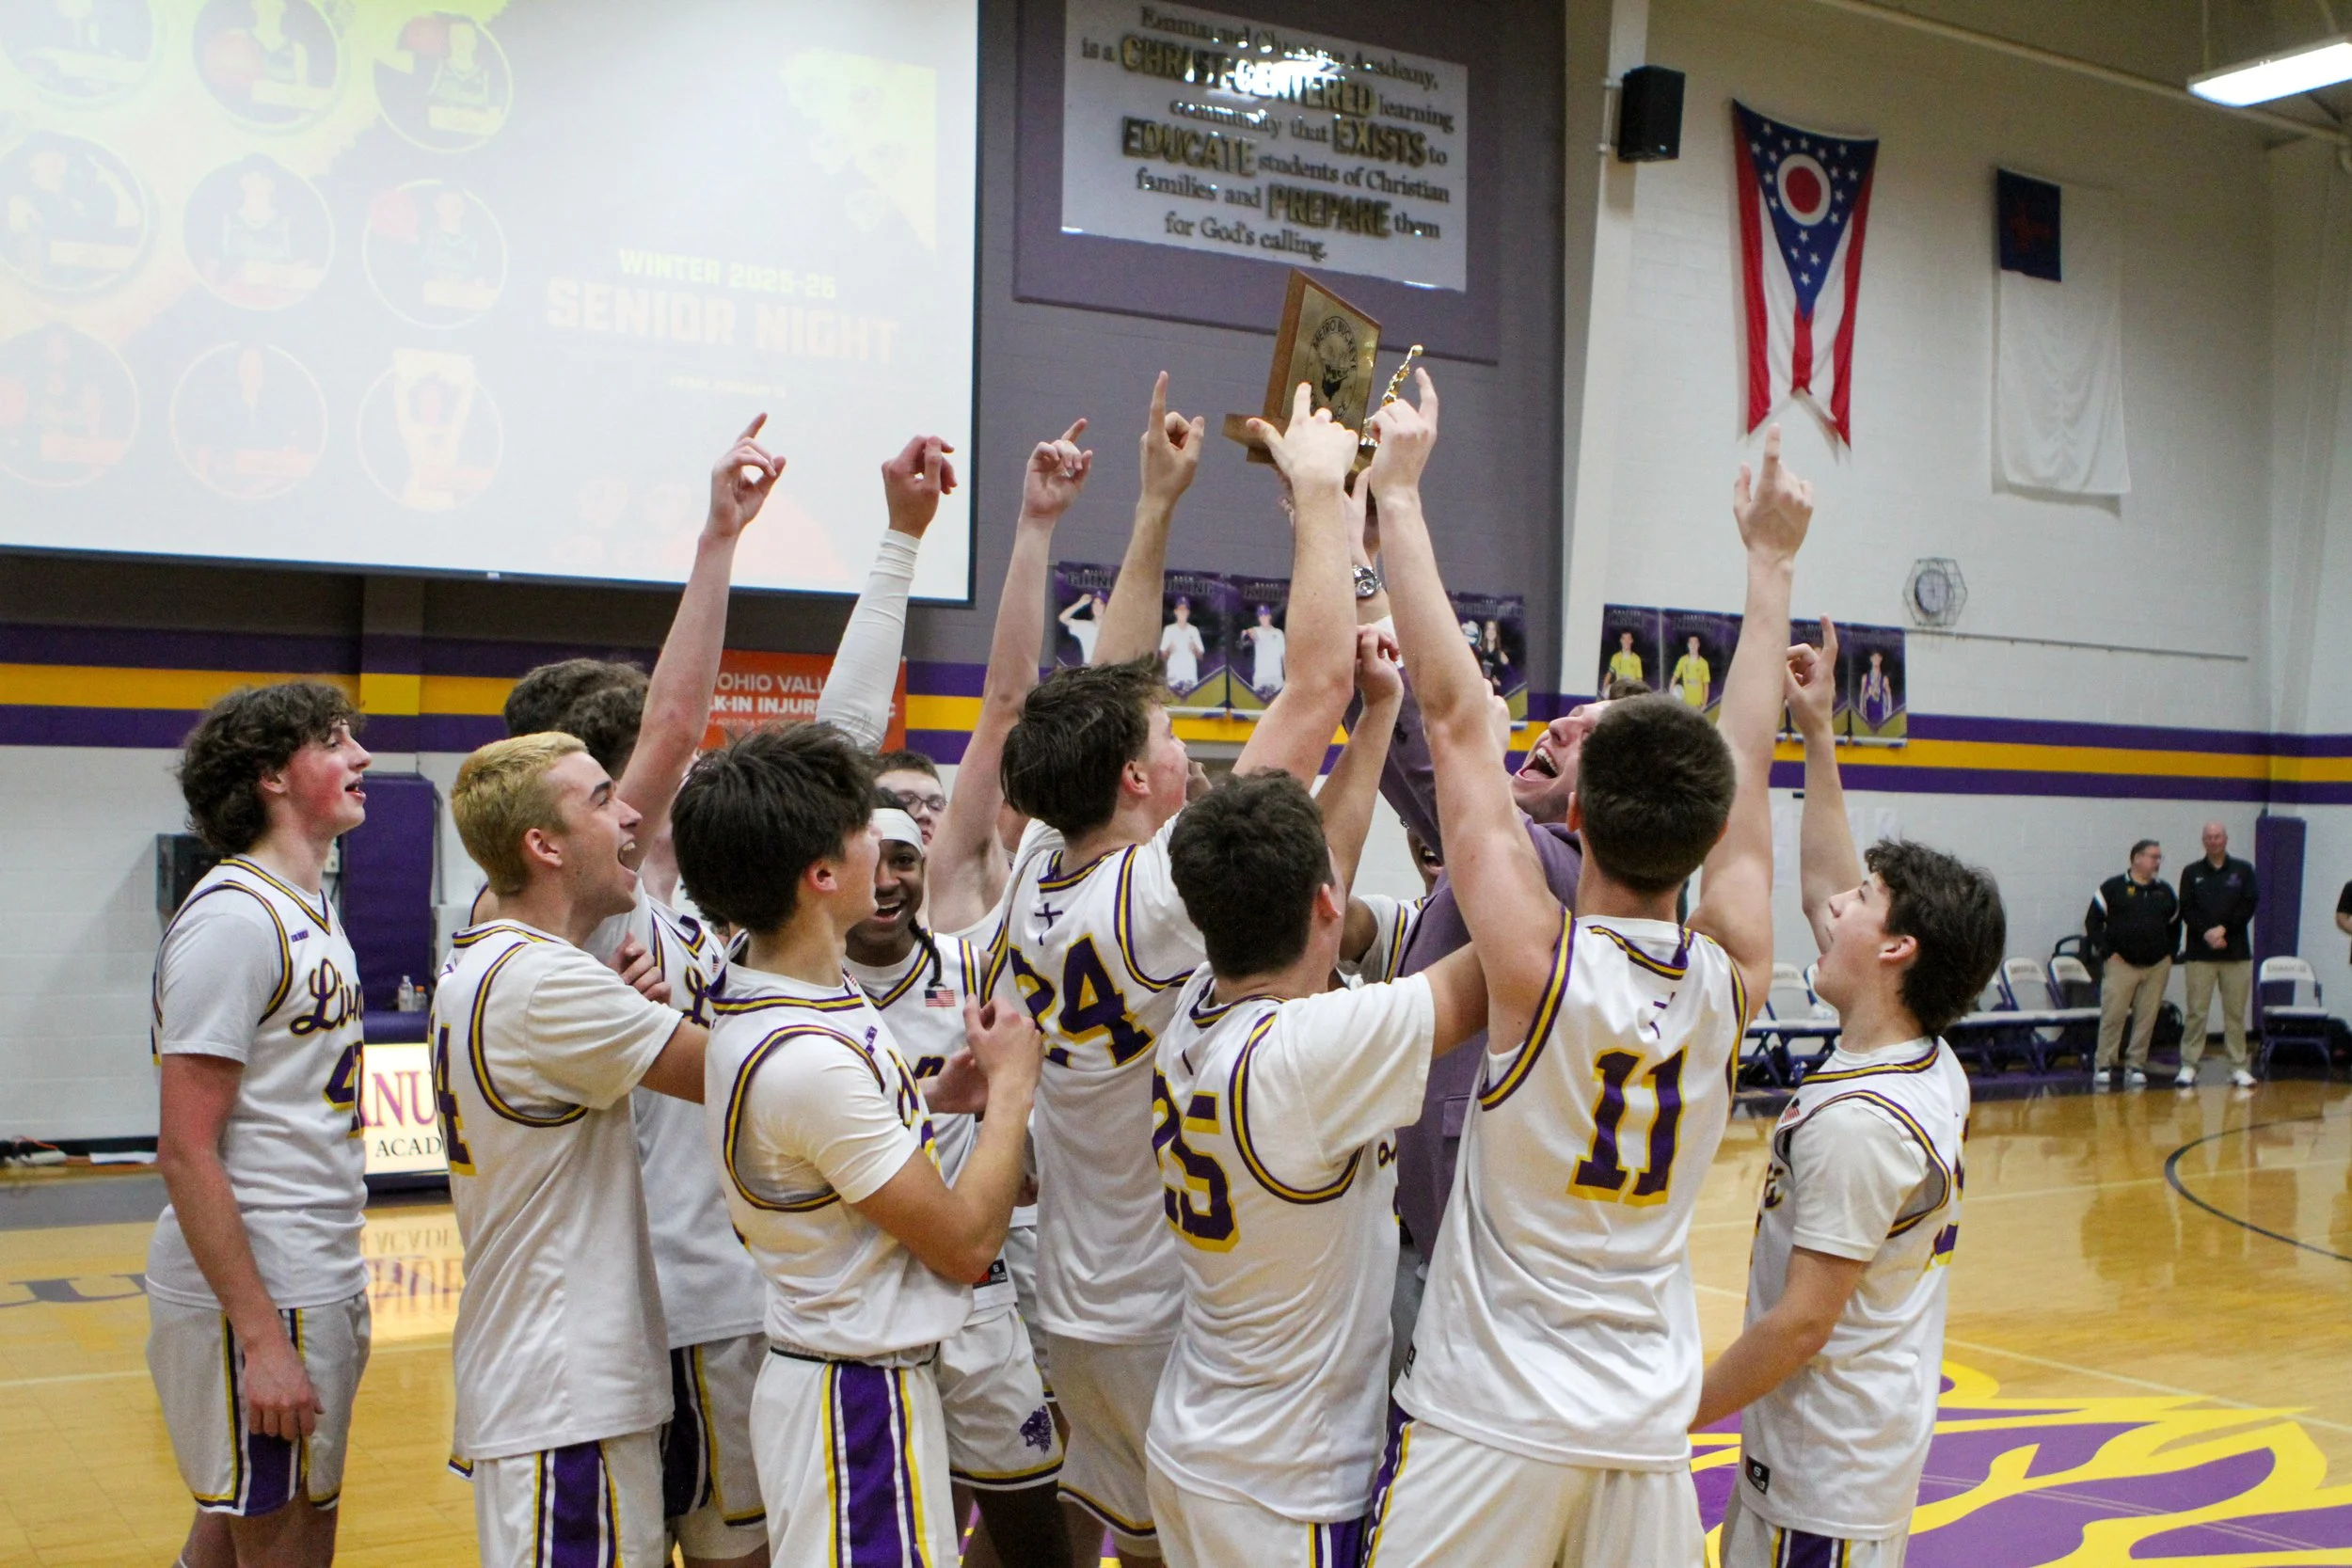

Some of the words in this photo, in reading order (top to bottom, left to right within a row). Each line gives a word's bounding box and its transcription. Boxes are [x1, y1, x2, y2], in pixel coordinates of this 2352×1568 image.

[1083, 37, 1099, 58] is
[1378, 93, 1454, 134] learning
[1121, 115, 1257, 178] EDUCATE
[1259, 153, 1340, 183] students
[1343, 166, 1364, 187] of
[1366, 169, 1451, 203] Christian
[1169, 100, 1281, 139] community
[1291, 119, 1328, 143] that
[1333, 117, 1426, 167] EXISTS
[1429, 145, 1448, 166] to
[1136, 166, 1217, 201] families
[1224, 185, 1262, 209] and
[1268, 182, 1392, 239] PREPARE
[1394, 212, 1440, 239] them
[1165, 210, 1195, 236] for
[1200, 215, 1256, 245] God's
[1260, 229, 1327, 263] calling.
[618, 247, 722, 285] WINTER
[546, 276, 737, 347] SENIOR
[755, 301, 902, 365] NIGHT
[708, 694, 753, 713] K-IN
[716, 672, 772, 692] OHIO
[1009, 932, 1157, 1069] 24
[1565, 1044, 1690, 1209] 11
